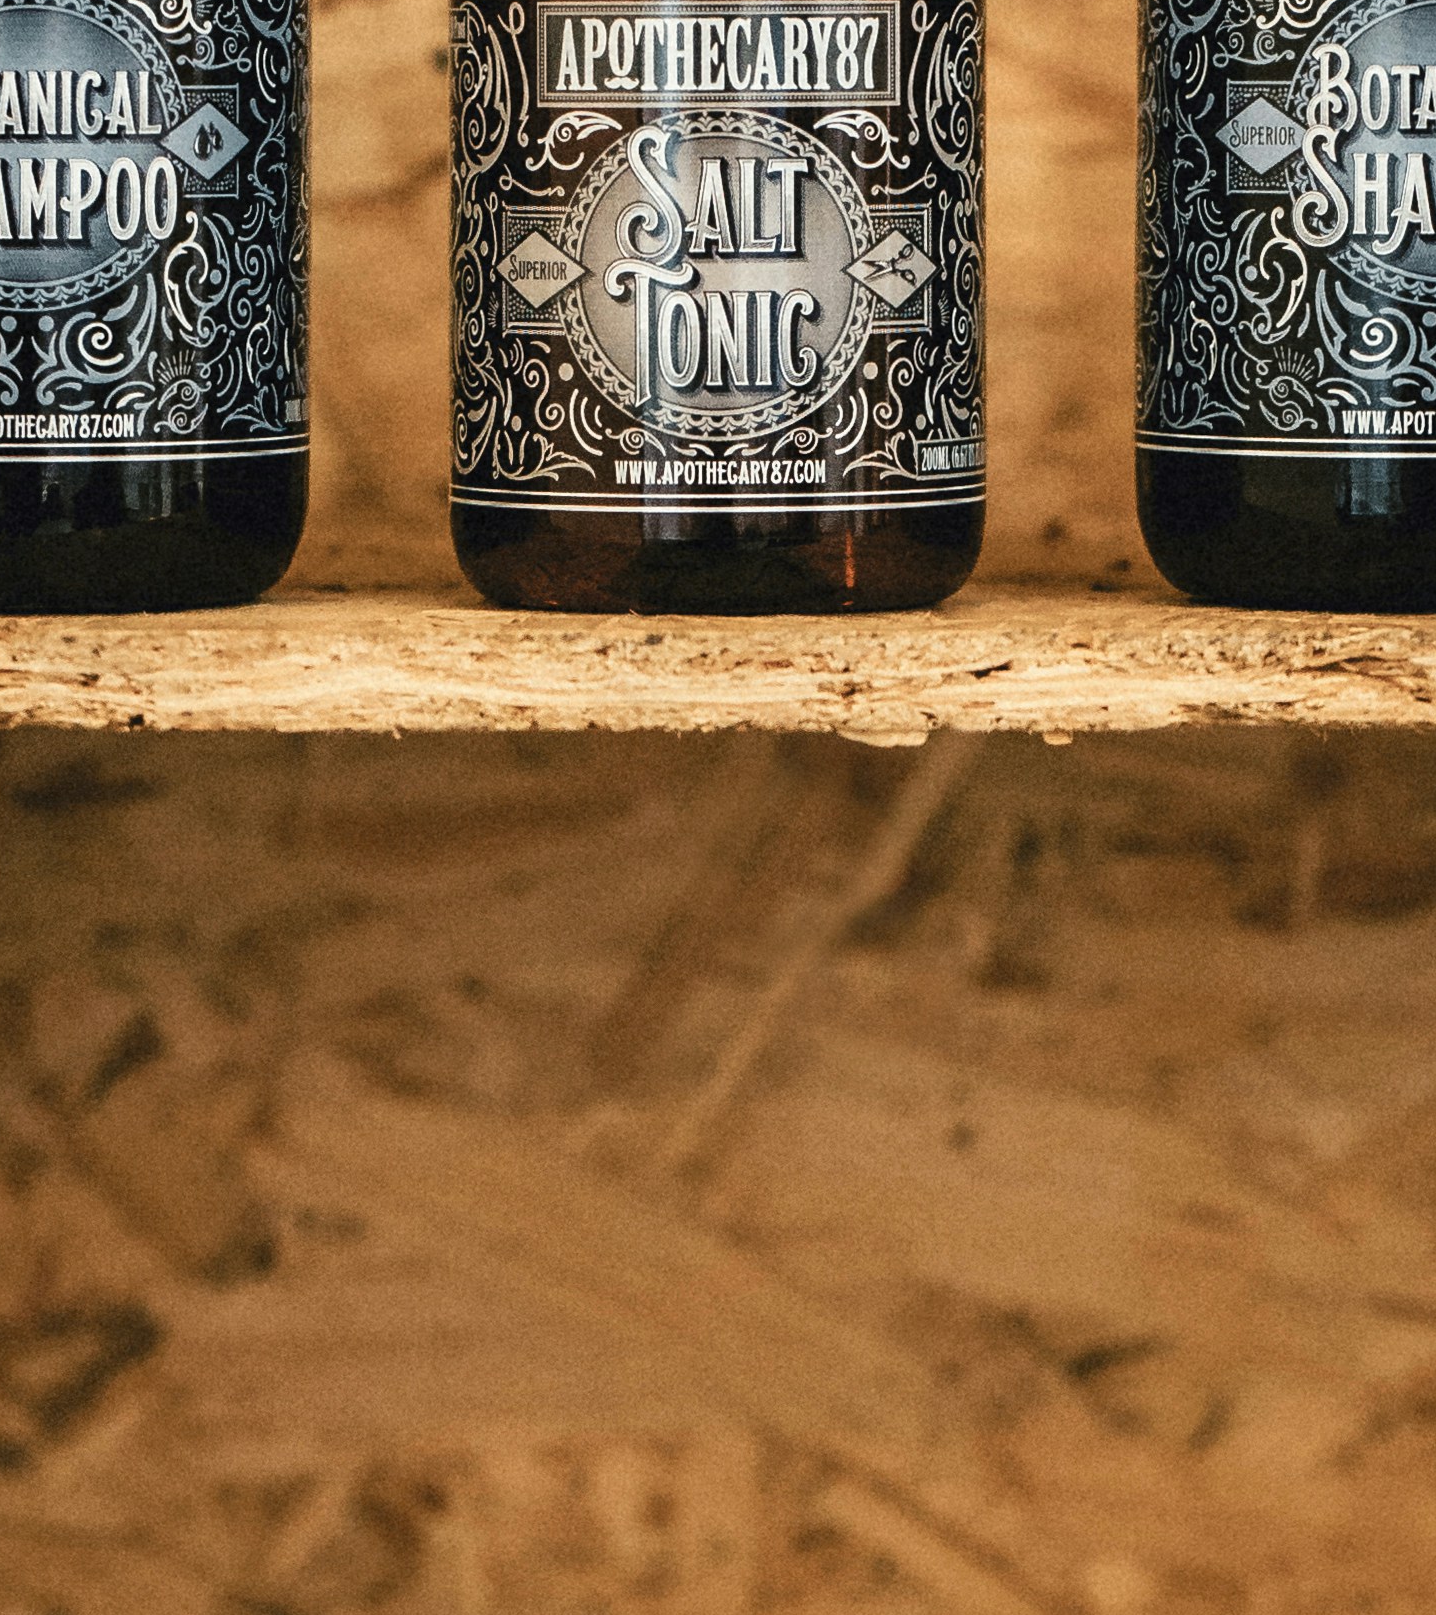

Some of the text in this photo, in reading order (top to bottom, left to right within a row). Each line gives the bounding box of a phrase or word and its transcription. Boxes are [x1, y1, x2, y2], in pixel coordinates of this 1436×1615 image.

[555, 16, 880, 92] APOTHECARY87
[1228, 119, 1296, 149] SUPERIOR
[615, 127, 809, 263] SALT
[507, 253, 568, 283] SUPERIOR
[604, 259, 818, 409] TONIC
[614, 459, 826, 486] WWW.APOTHECARY87.COM
